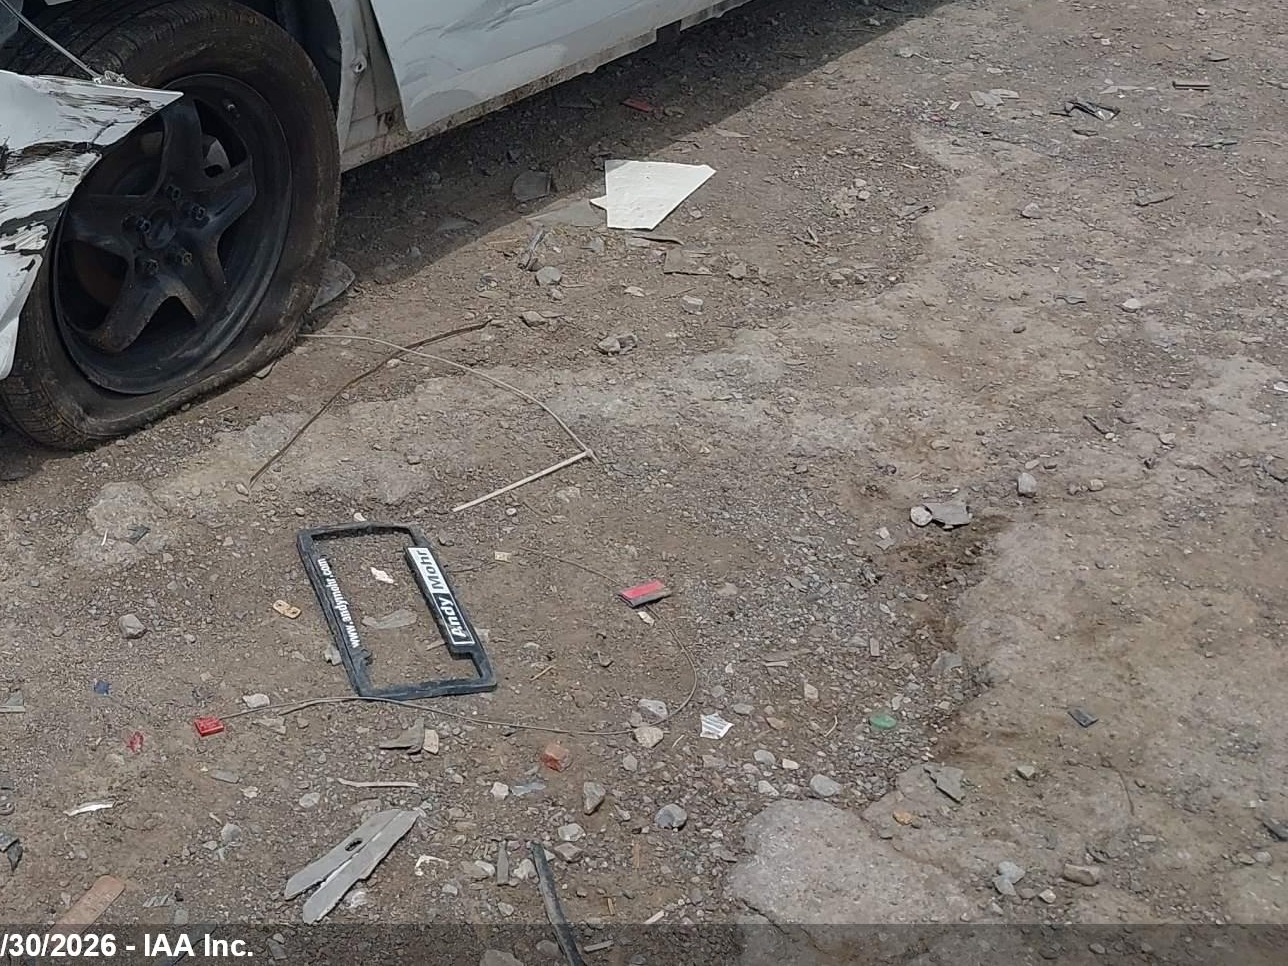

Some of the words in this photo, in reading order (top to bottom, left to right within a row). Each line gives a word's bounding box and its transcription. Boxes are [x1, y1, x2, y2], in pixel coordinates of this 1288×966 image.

[414, 549, 445, 590] Mohr
[317, 557, 361, 649] www.andymohr.com
[438, 597, 467, 638] Andy
